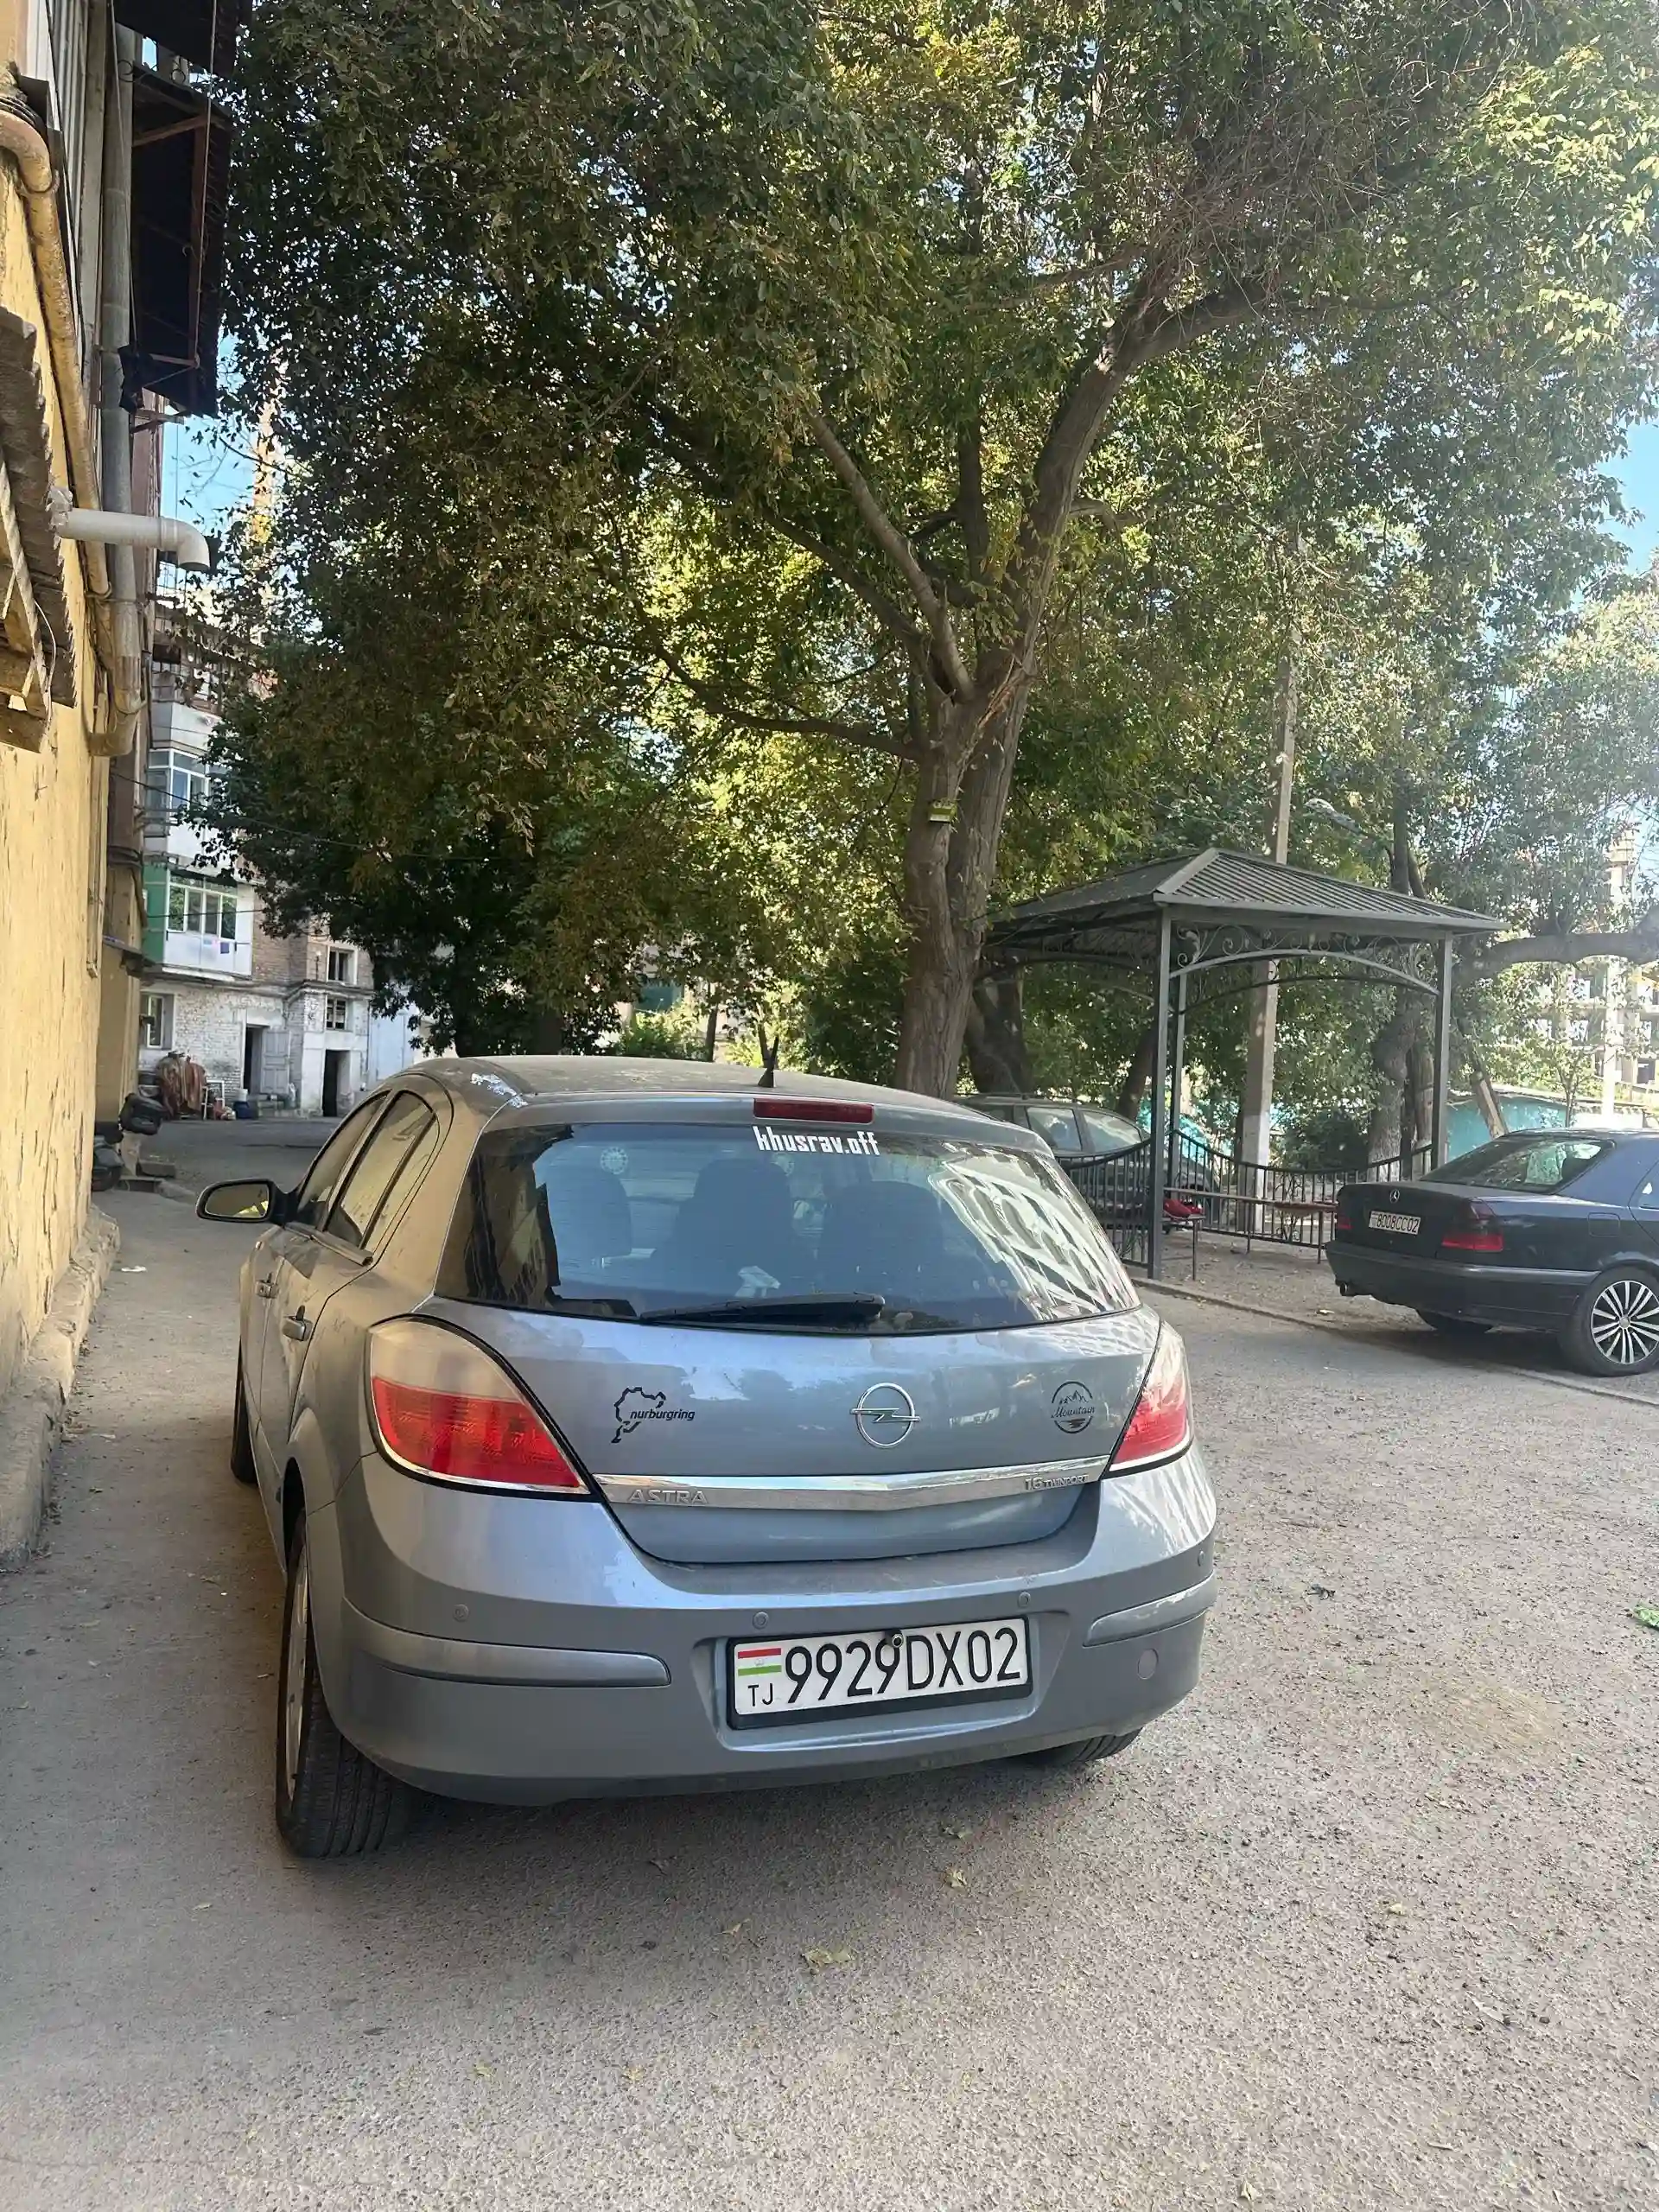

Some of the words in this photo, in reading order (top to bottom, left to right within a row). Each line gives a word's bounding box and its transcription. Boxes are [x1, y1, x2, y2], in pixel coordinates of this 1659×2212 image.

[753, 1125, 880, 1156] khusrav.off
[629, 1408, 696, 1421] nurburgring
[627, 1488, 709, 1504] ASTRA
[785, 1627, 1021, 1704] 9929DX02
[747, 1682, 773, 1707] TJ
